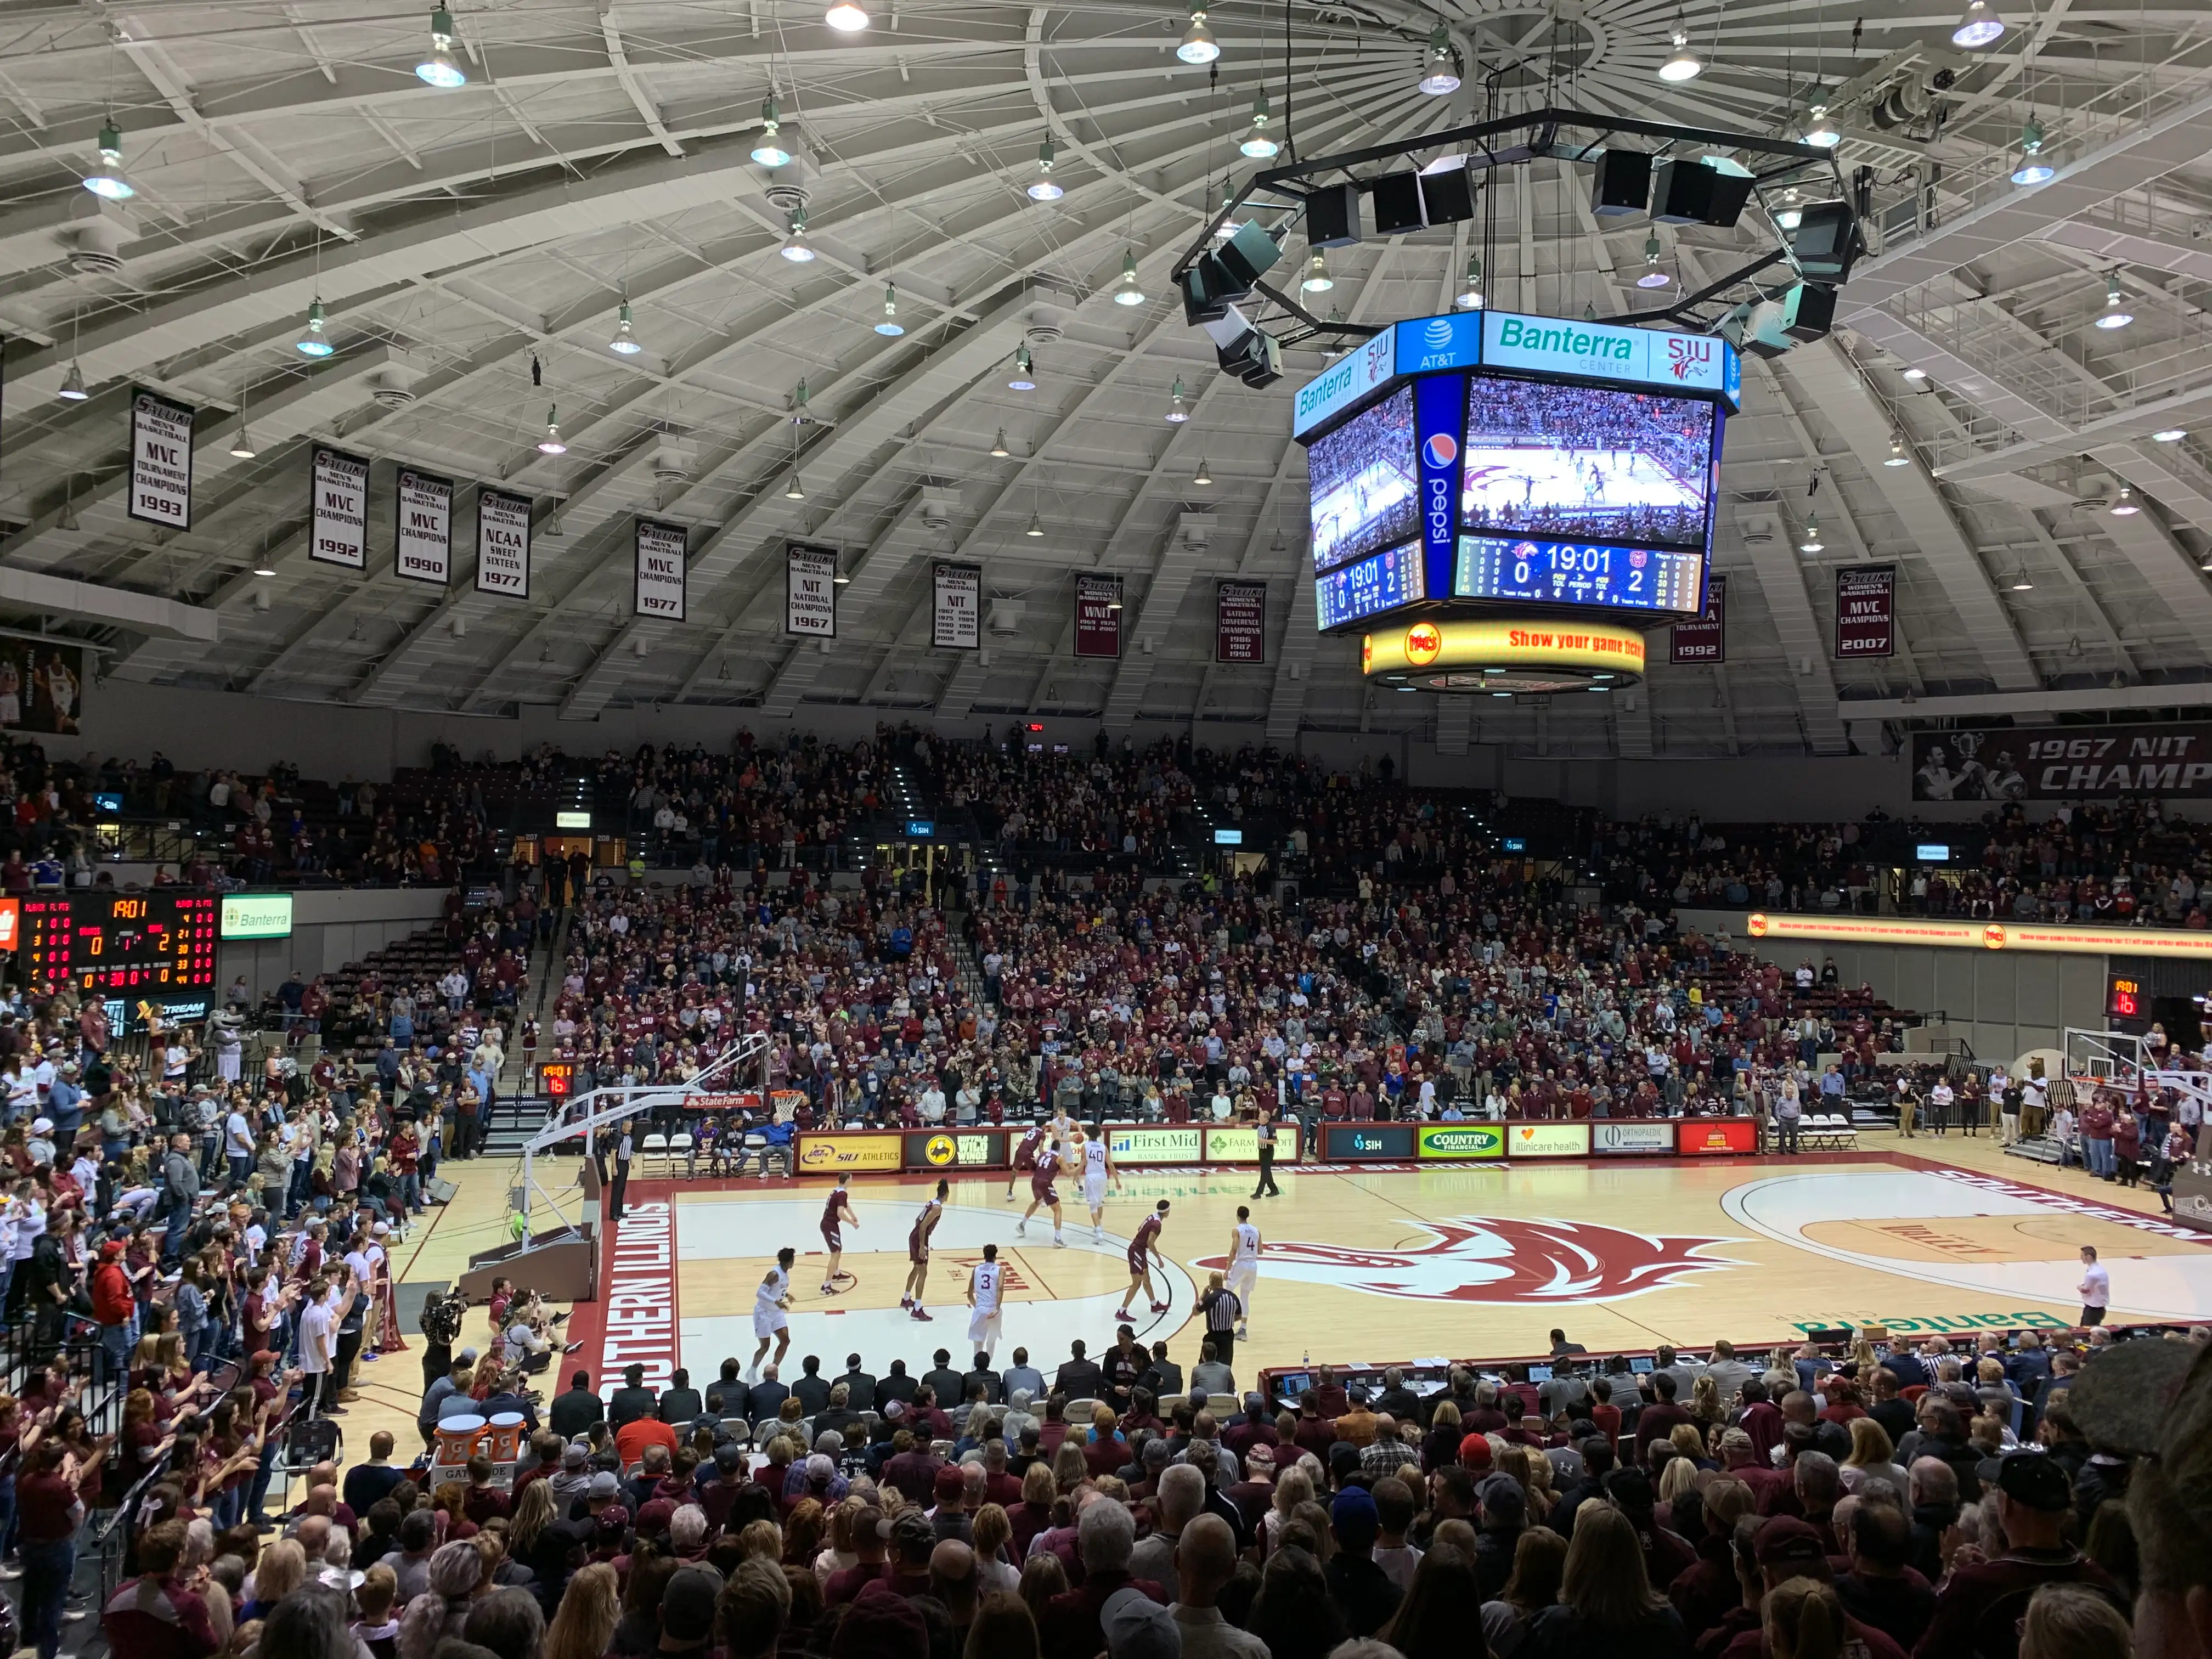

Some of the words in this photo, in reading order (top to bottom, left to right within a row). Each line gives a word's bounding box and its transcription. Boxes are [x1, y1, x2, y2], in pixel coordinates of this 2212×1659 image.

[1500, 319, 1632, 359] Banterra
[1368, 334, 1389, 366] SIU
[1668, 338, 1710, 362] SIU
[1420, 352, 1457, 369] AT&T
[1580, 359, 1630, 374] CENTER
[1299, 366, 1352, 417] Banterra
[1329, 390, 1351, 410] CENTER
[150, 418, 176, 432] MEN'S
[136, 421, 188, 444] BASKETBALL
[146, 441, 178, 466] MVC
[137, 460, 187, 482] TOURNAMENT
[329, 470, 352, 483] MEN'S
[136, 473, 187, 496] CHAMPIONS
[317, 475, 363, 493] BASKETBALL
[325, 492, 354, 513] MVC
[402, 495, 448, 511] BASKETBALL
[414, 491, 436, 503] MEN'S
[139, 494, 182, 517] 1993
[1428, 478, 1453, 544] pepsi
[316, 508, 363, 527] CHAMPIONS
[410, 511, 438, 531] MVC
[482, 514, 527, 528] BASKETBALL
[494, 510, 516, 520] MEN'S
[402, 527, 447, 545] CHAMPIONS
[486, 528, 522, 549] NCAA
[319, 538, 359, 558] 1992
[640, 544, 682, 556] BASKETBALL
[651, 540, 672, 549] MEN'S
[490, 546, 517, 558] SWEET
[1547, 545, 1611, 573] 19:01
[404, 556, 443, 574] 1990
[486, 556, 521, 570] SIXTEEN
[648, 557, 674, 574] MVC
[640, 571, 682, 585] CHAMPIONS
[791, 567, 832, 576] BASKETBALL
[1349, 559, 1378, 590] 19:01
[1514, 561, 1529, 584] 0
[484, 571, 521, 588] 1977
[802, 579, 821, 593] NIT
[1387, 572, 1395, 592] 2
[1628, 570, 1643, 592] 2
[794, 593, 829, 603] NATIONAL
[1339, 589, 1345, 609] 0
[1841, 589, 1889, 597] BASKETBALL
[643, 597, 678, 611] 1977
[791, 602, 832, 613] CHAMPIONS
[947, 595, 966, 608] NIT
[1850, 601, 1880, 614] MVC
[1085, 606, 1112, 618] WNIT
[1841, 614, 1889, 624] CHAMPIONS
[794, 616, 829, 629] 1967
[1675, 623, 1720, 631] TOURNAMENT
[1509, 630, 1554, 647] Show
[1557, 635, 1590, 650] your
[1592, 636, 1623, 654] game
[1842, 637, 1887, 650] 2007
[1678, 645, 1717, 657] 1992
[2028, 738, 2117, 760] 1967
[2129, 736, 2197, 758] NIT
[113, 900, 147, 918] 19:01
[240, 913, 287, 927] Banterra
[91, 936, 103, 955] 0
[159, 933, 170, 951] 2
[2115, 980, 2138, 994] 19:01
[2119, 994, 2134, 1013] 16
[641, 1017, 653, 1025] SIU
[543, 1066, 571, 1077] 19:01
[550, 1079, 565, 1093] 16
[623, 1103, 642, 1113] Sports
[1622, 1128, 1662, 1137] ORTHOPAEDIC
[957, 1142, 988, 1152] WILD
[1133, 1134, 1167, 1148] First
[1170, 1133, 1198, 1147] Mid
[1229, 1137, 1255, 1147] FARM
[1365, 1140, 1382, 1150] SIH
[1434, 1134, 1489, 1146] COUNTRY
[1516, 1142, 1552, 1152] illinicare
[1554, 1141, 1581, 1151] health
[836, 1153, 861, 1163] SIU
[862, 1153, 899, 1161] ATHLETICS
[957, 1151, 988, 1160] WINGS
[1088, 1150, 1103, 1163] 40
[1117, 1167, 1218, 1175] HARRY
[1922, 1170, 2212, 1240] SOUTHERN
[612, 1203, 670, 1273] ILLINOIS
[1246, 1237, 1255, 1251] 4
[1878, 1224, 2016, 1254] VALLEY
[947, 1268, 966, 1282] THE
[980, 1274, 990, 1290] 3
[598, 1277, 673, 1413] OUTHERN
[451, 1442, 462, 1453] G
[499, 1436, 511, 1447] G
[445, 1467, 507, 1479] GATDE
